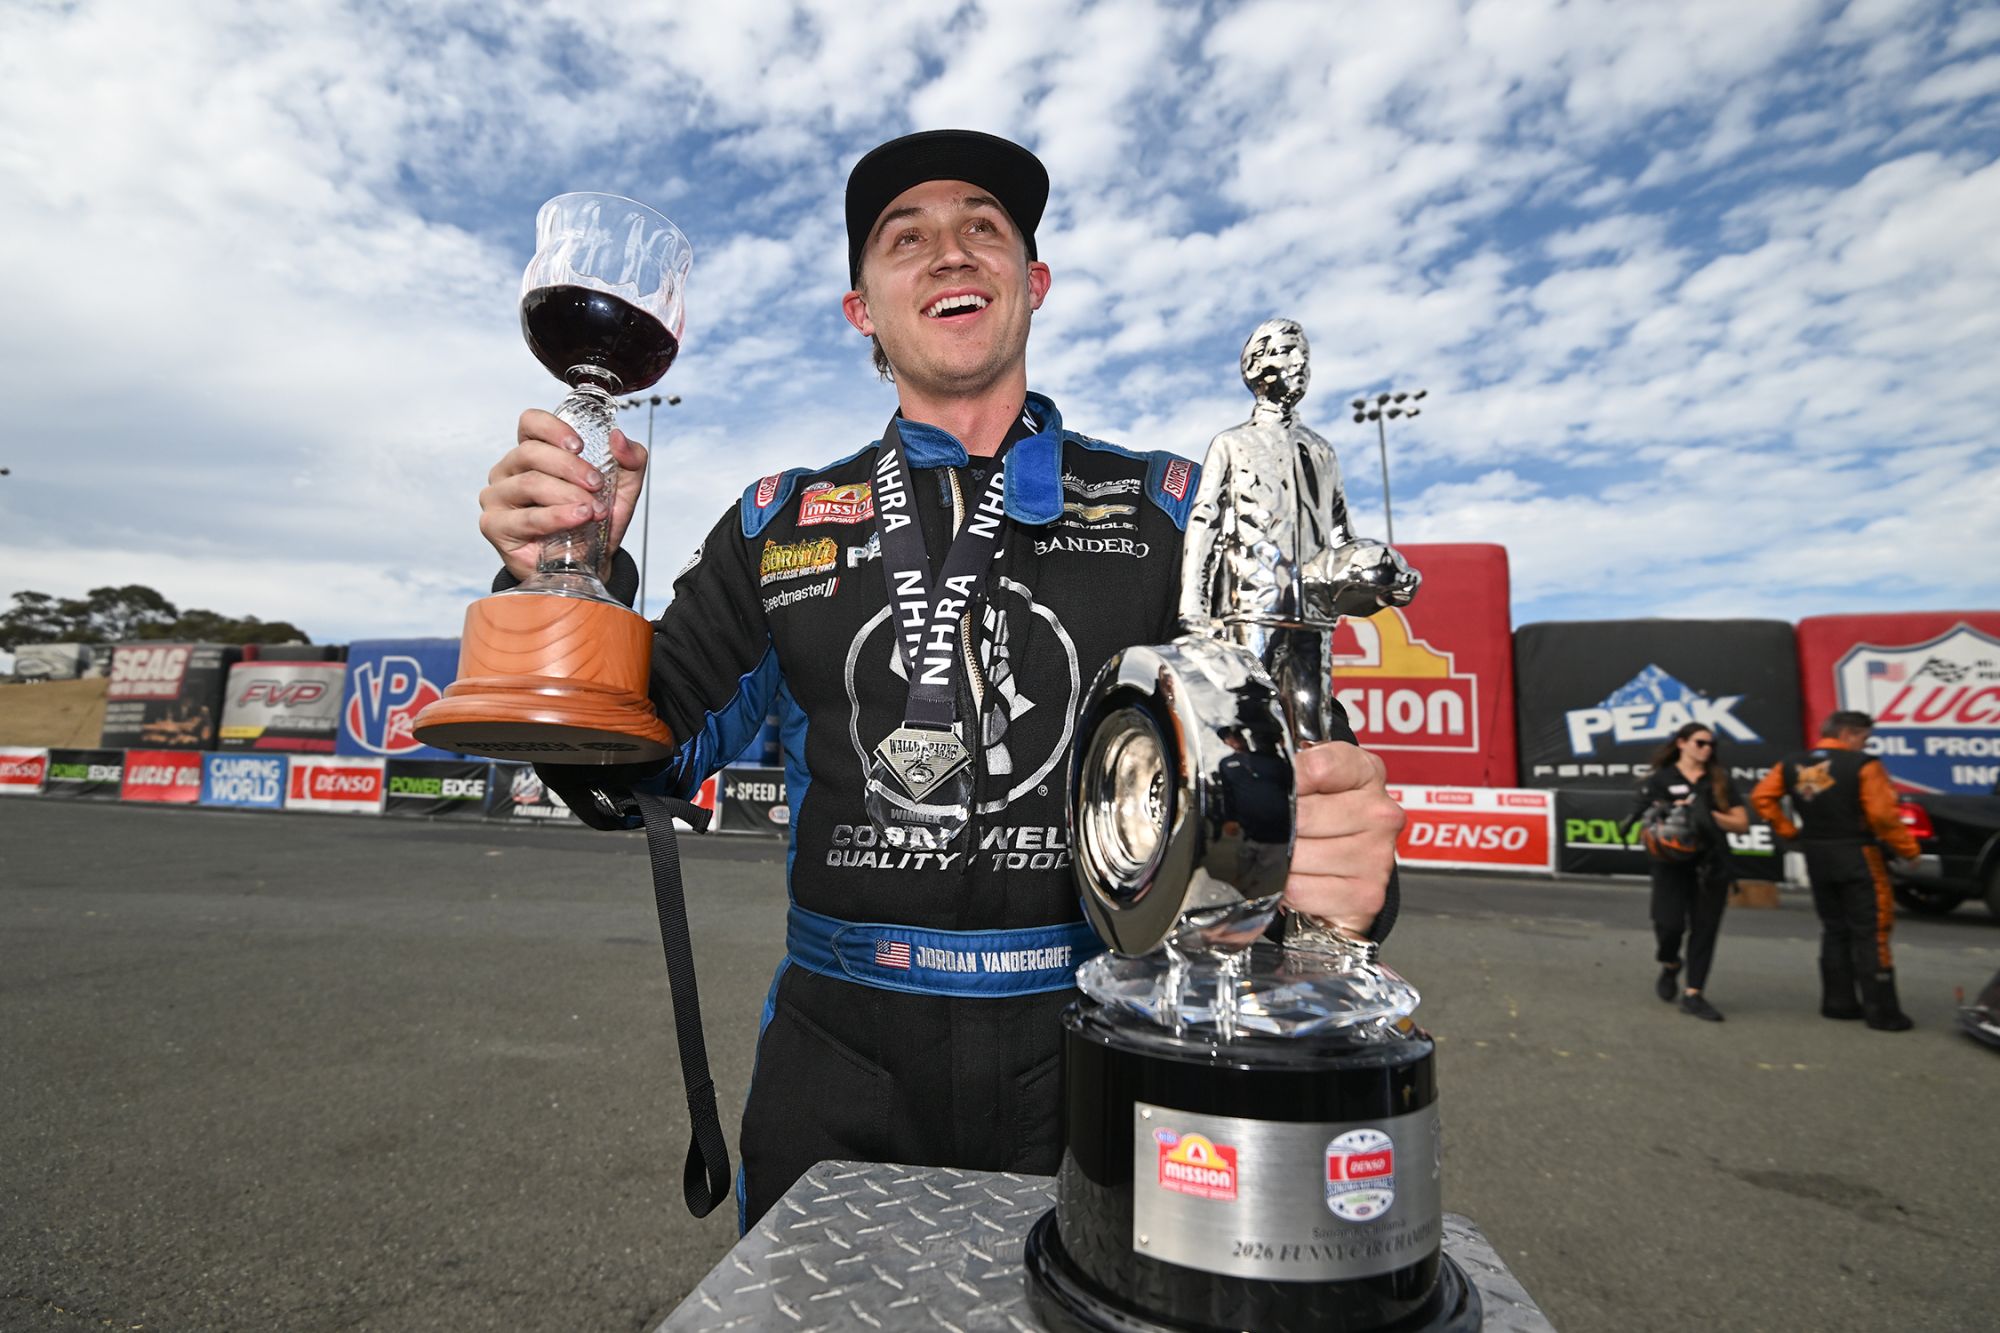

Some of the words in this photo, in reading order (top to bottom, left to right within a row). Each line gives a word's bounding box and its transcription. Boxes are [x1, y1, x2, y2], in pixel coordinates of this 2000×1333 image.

[877, 448, 911, 533] NHRA
[920, 574, 977, 685] NHRA
[112, 648, 188, 681] SCAG
[239, 680, 328, 708] FVP
[354, 656, 422, 750] VP
[1876, 686, 2000, 724] LUC
[1566, 696, 1761, 754] PEAK
[1864, 736, 1917, 755] OIL
[128, 765, 175, 786] LUCAS
[175, 767, 201, 786] OIL
[210, 758, 281, 779] CAMPING
[211, 778, 280, 803] WORLD
[314, 773, 376, 793] DENSO
[737, 781, 776, 800] SPEED
[890, 808, 941, 824] WINNER
[1408, 822, 1529, 851] DENSO
[826, 850, 962, 871] QUALITY
[917, 945, 977, 973] JORDAN
[981, 945, 1073, 973] VANDERGRIFF
[1232, 1240, 1276, 1260] 2026
